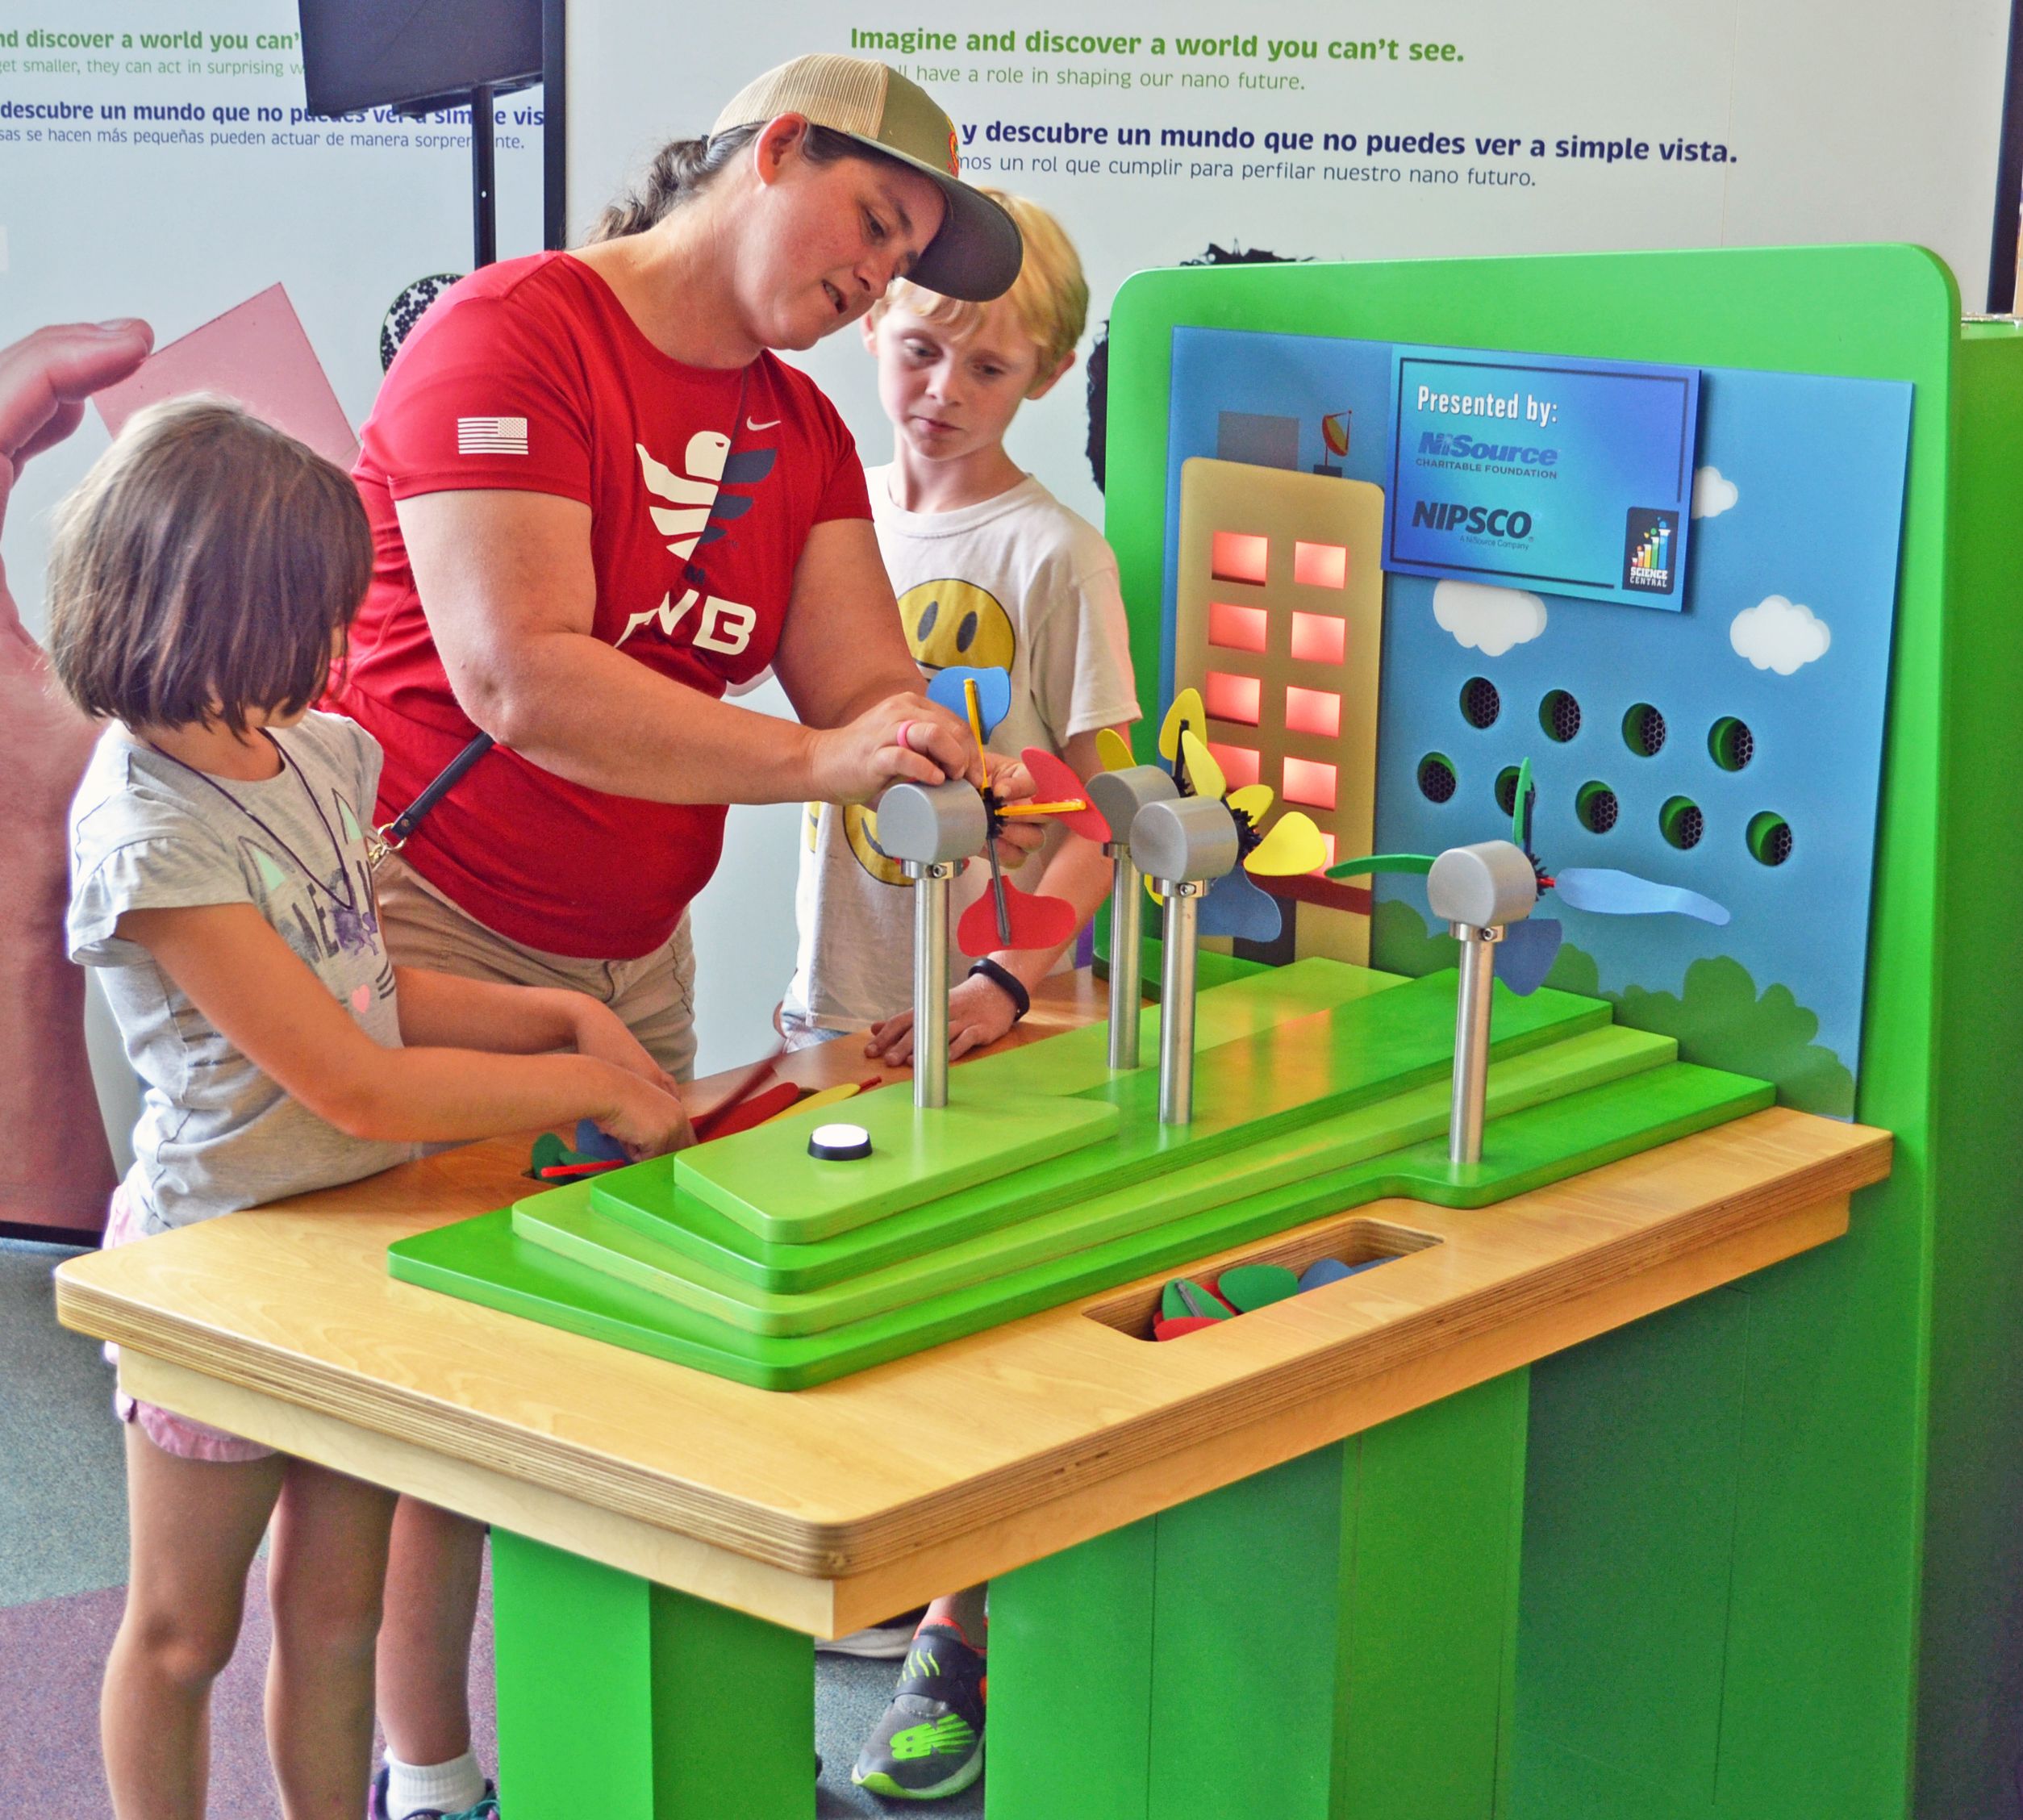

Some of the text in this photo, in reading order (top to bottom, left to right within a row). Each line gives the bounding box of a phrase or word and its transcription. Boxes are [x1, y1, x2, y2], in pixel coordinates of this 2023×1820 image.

[26, 29, 115, 48] discover
[121, 34, 132, 48] a
[140, 30, 202, 49] world
[210, 35, 248, 52] you
[256, 32, 299, 50] can'
[852, 27, 1465, 62] Imagine and discover a world you can't see.
[23, 59, 81, 76] smaller,
[87, 59, 120, 76] they
[125, 62, 152, 73] can
[157, 61, 181, 74] act
[188, 59, 202, 74] in
[207, 60, 284, 77] surprising
[916, 65, 961, 82] have
[968, 68, 978, 82] a
[987, 66, 1024, 84] role
[1032, 66, 1049, 84] in
[1057, 67, 1132, 90] shaping
[1140, 73, 1174, 87] our
[1182, 73, 1230, 89] nano
[1238, 70, 1305, 90] future.
[1, 101, 94, 119] descubre
[101, 105, 126, 120] un
[134, 102, 205, 121] mundo
[212, 106, 250, 125] que
[257, 107, 283, 122] no
[435, 109, 507, 126] sime
[514, 106, 544, 126] vis
[27, 130, 43, 142] se
[48, 127, 91, 142] hacen
[98, 127, 127, 143] más
[133, 128, 204, 146] pequeñas
[211, 130, 265, 146] pueden
[271, 132, 320, 146] actuar
[326, 131, 344, 146] de
[350, 134, 409, 147] manera
[962, 120, 1737, 163] y descubre un mundo que no puedes ver a simple vista.
[1000, 157, 1024, 171] un
[1032, 156, 1057, 173] rol
[1066, 159, 1100, 176] que
[1108, 158, 1183, 178] cumplir
[1191, 162, 1233, 179] para
[1242, 161, 1316, 181] perfilar
[1324, 165, 1401, 182] nuestro
[1409, 168, 1458, 184] nano
[1467, 166, 1536, 187] futuro.
[1417, 385, 1558, 428] Presented by:
[1417, 431, 1558, 466] NiSource
[1416, 458, 1558, 479] CHARITABLE FOUNDATION
[1412, 500, 1533, 540] NIPSCO
[1497, 538, 1529, 551] Company
[1629, 576, 1667, 588] CENTRAL
[1630, 566, 1668, 580] SCIENCE
